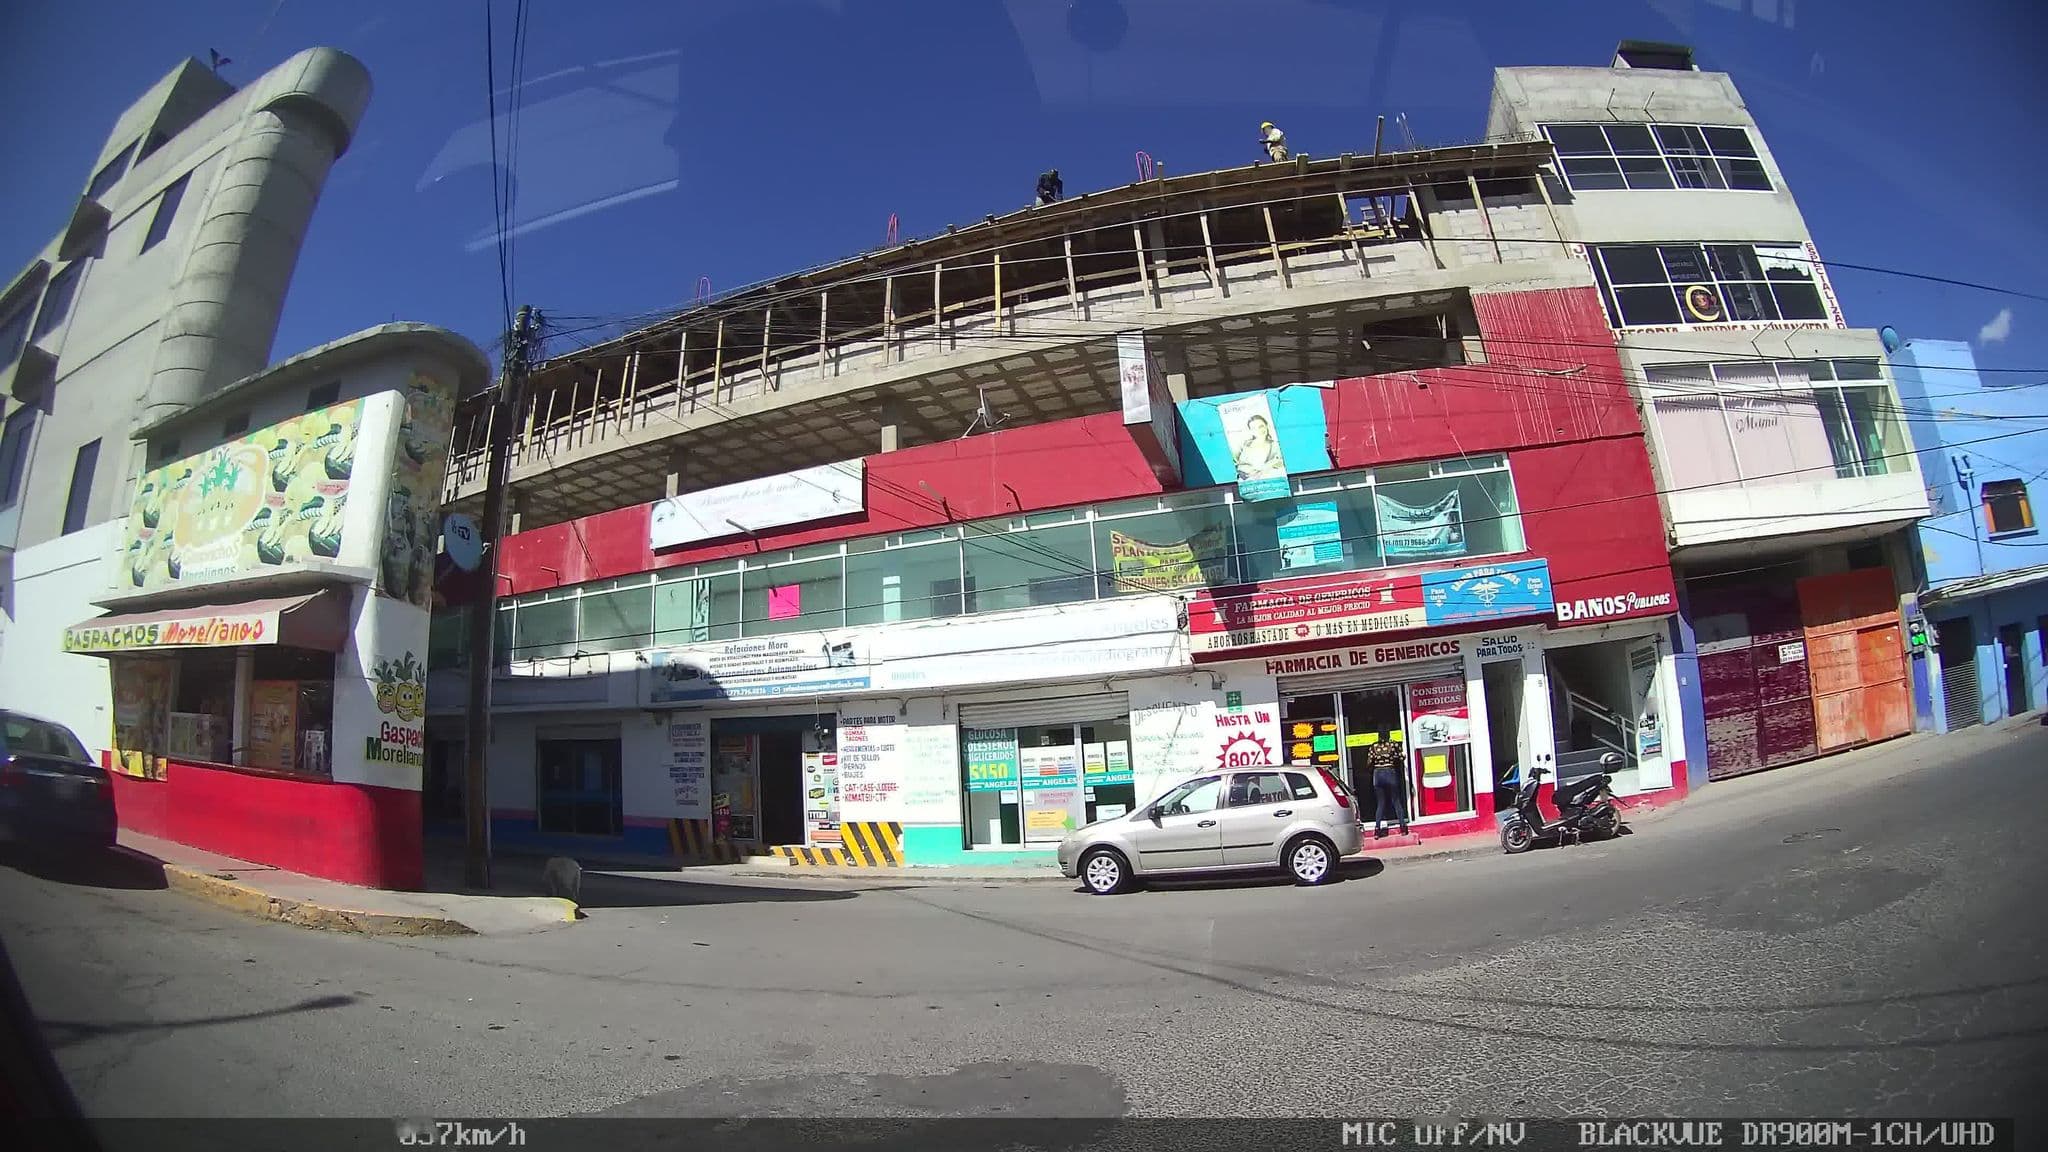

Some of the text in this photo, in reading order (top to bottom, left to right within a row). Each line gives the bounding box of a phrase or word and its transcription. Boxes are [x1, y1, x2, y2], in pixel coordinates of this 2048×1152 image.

[1234, 586, 1371, 612] FARMACIA DE GENERICOS
[1247, 613, 1272, 623] MEJOR
[1274, 609, 1305, 619] CALIDAD
[1307, 608, 1316, 616] AL
[1318, 605, 1342, 615] MEJOR
[1344, 601, 1371, 611] PRECIO
[1326, 622, 1343, 636] MAS
[1347, 620, 1358, 632] EN
[1361, 613, 1410, 631] MEDICINAS
[64, 623, 160, 651] GASPACHOS
[1482, 635, 1518, 646] SALUD
[768, 642, 788, 650] Mora
[1476, 643, 1523, 657] PARA TODOS
[1266, 640, 1461, 675] FARMACIA DE GENERICOS
[1412, 684, 1465, 697] CONSULTAS
[1418, 694, 1462, 707] MEDICAS
[968, 729, 1007, 740] GLUCOSA
[1229, 751, 1262, 768] 80%
